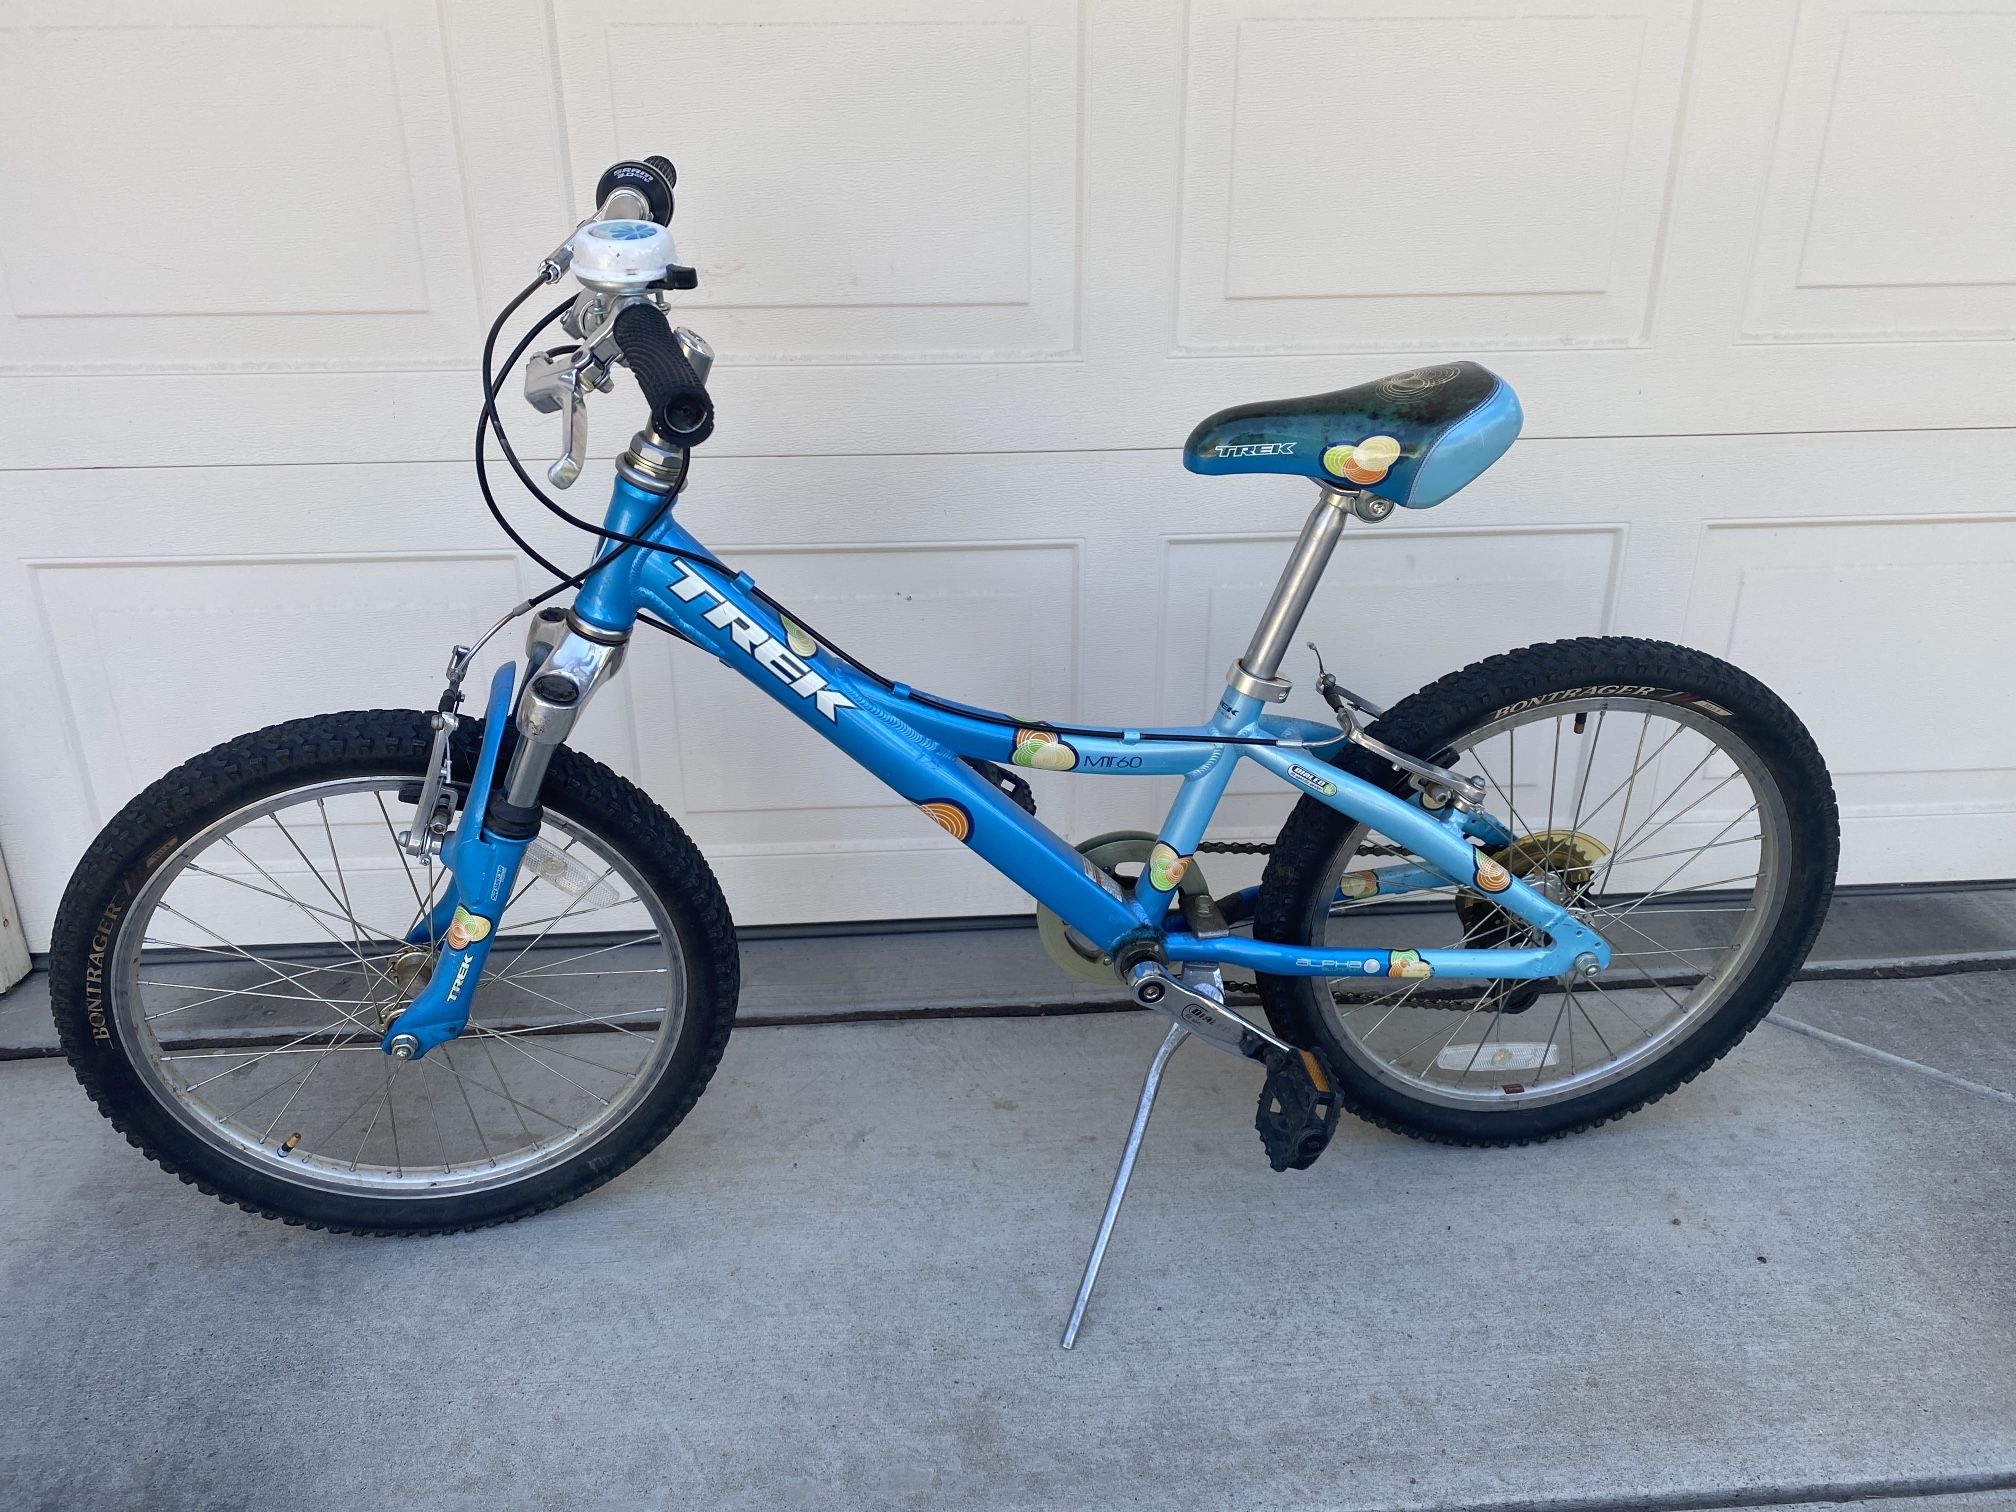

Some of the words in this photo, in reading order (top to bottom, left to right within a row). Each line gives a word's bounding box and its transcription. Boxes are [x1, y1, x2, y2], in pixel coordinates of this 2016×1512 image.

[1215, 442, 1297, 457] TREK
[667, 556, 865, 725] TREK
[1494, 684, 1656, 720] BONTRAGER
[86, 902, 123, 1040] BONTRAGER
[446, 952, 474, 1002] TREK
